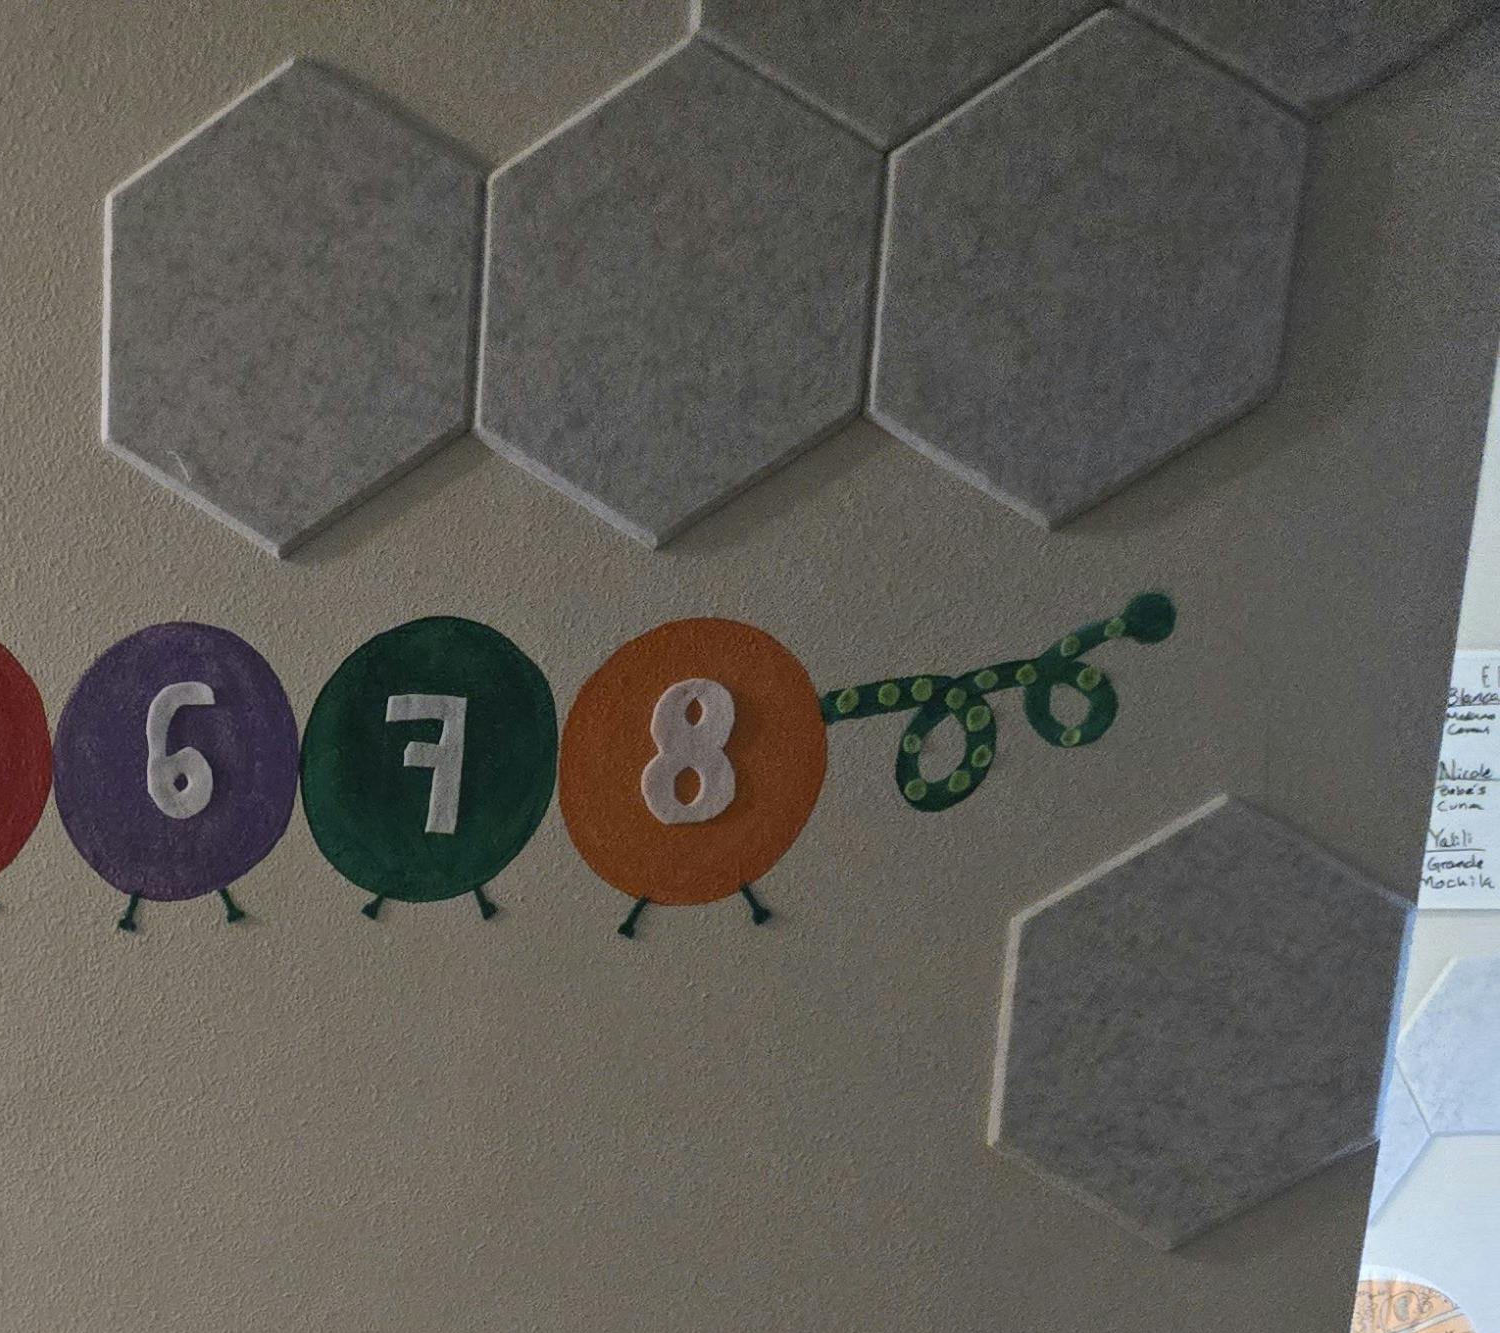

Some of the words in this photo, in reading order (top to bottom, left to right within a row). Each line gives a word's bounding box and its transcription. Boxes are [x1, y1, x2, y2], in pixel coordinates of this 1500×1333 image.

[146, 680, 216, 819] 6
[385, 694, 468, 834] 7
[641, 677, 736, 825] 8
[1439, 759, 1493, 780] Nicole
[1427, 855, 1484, 873] Grande
